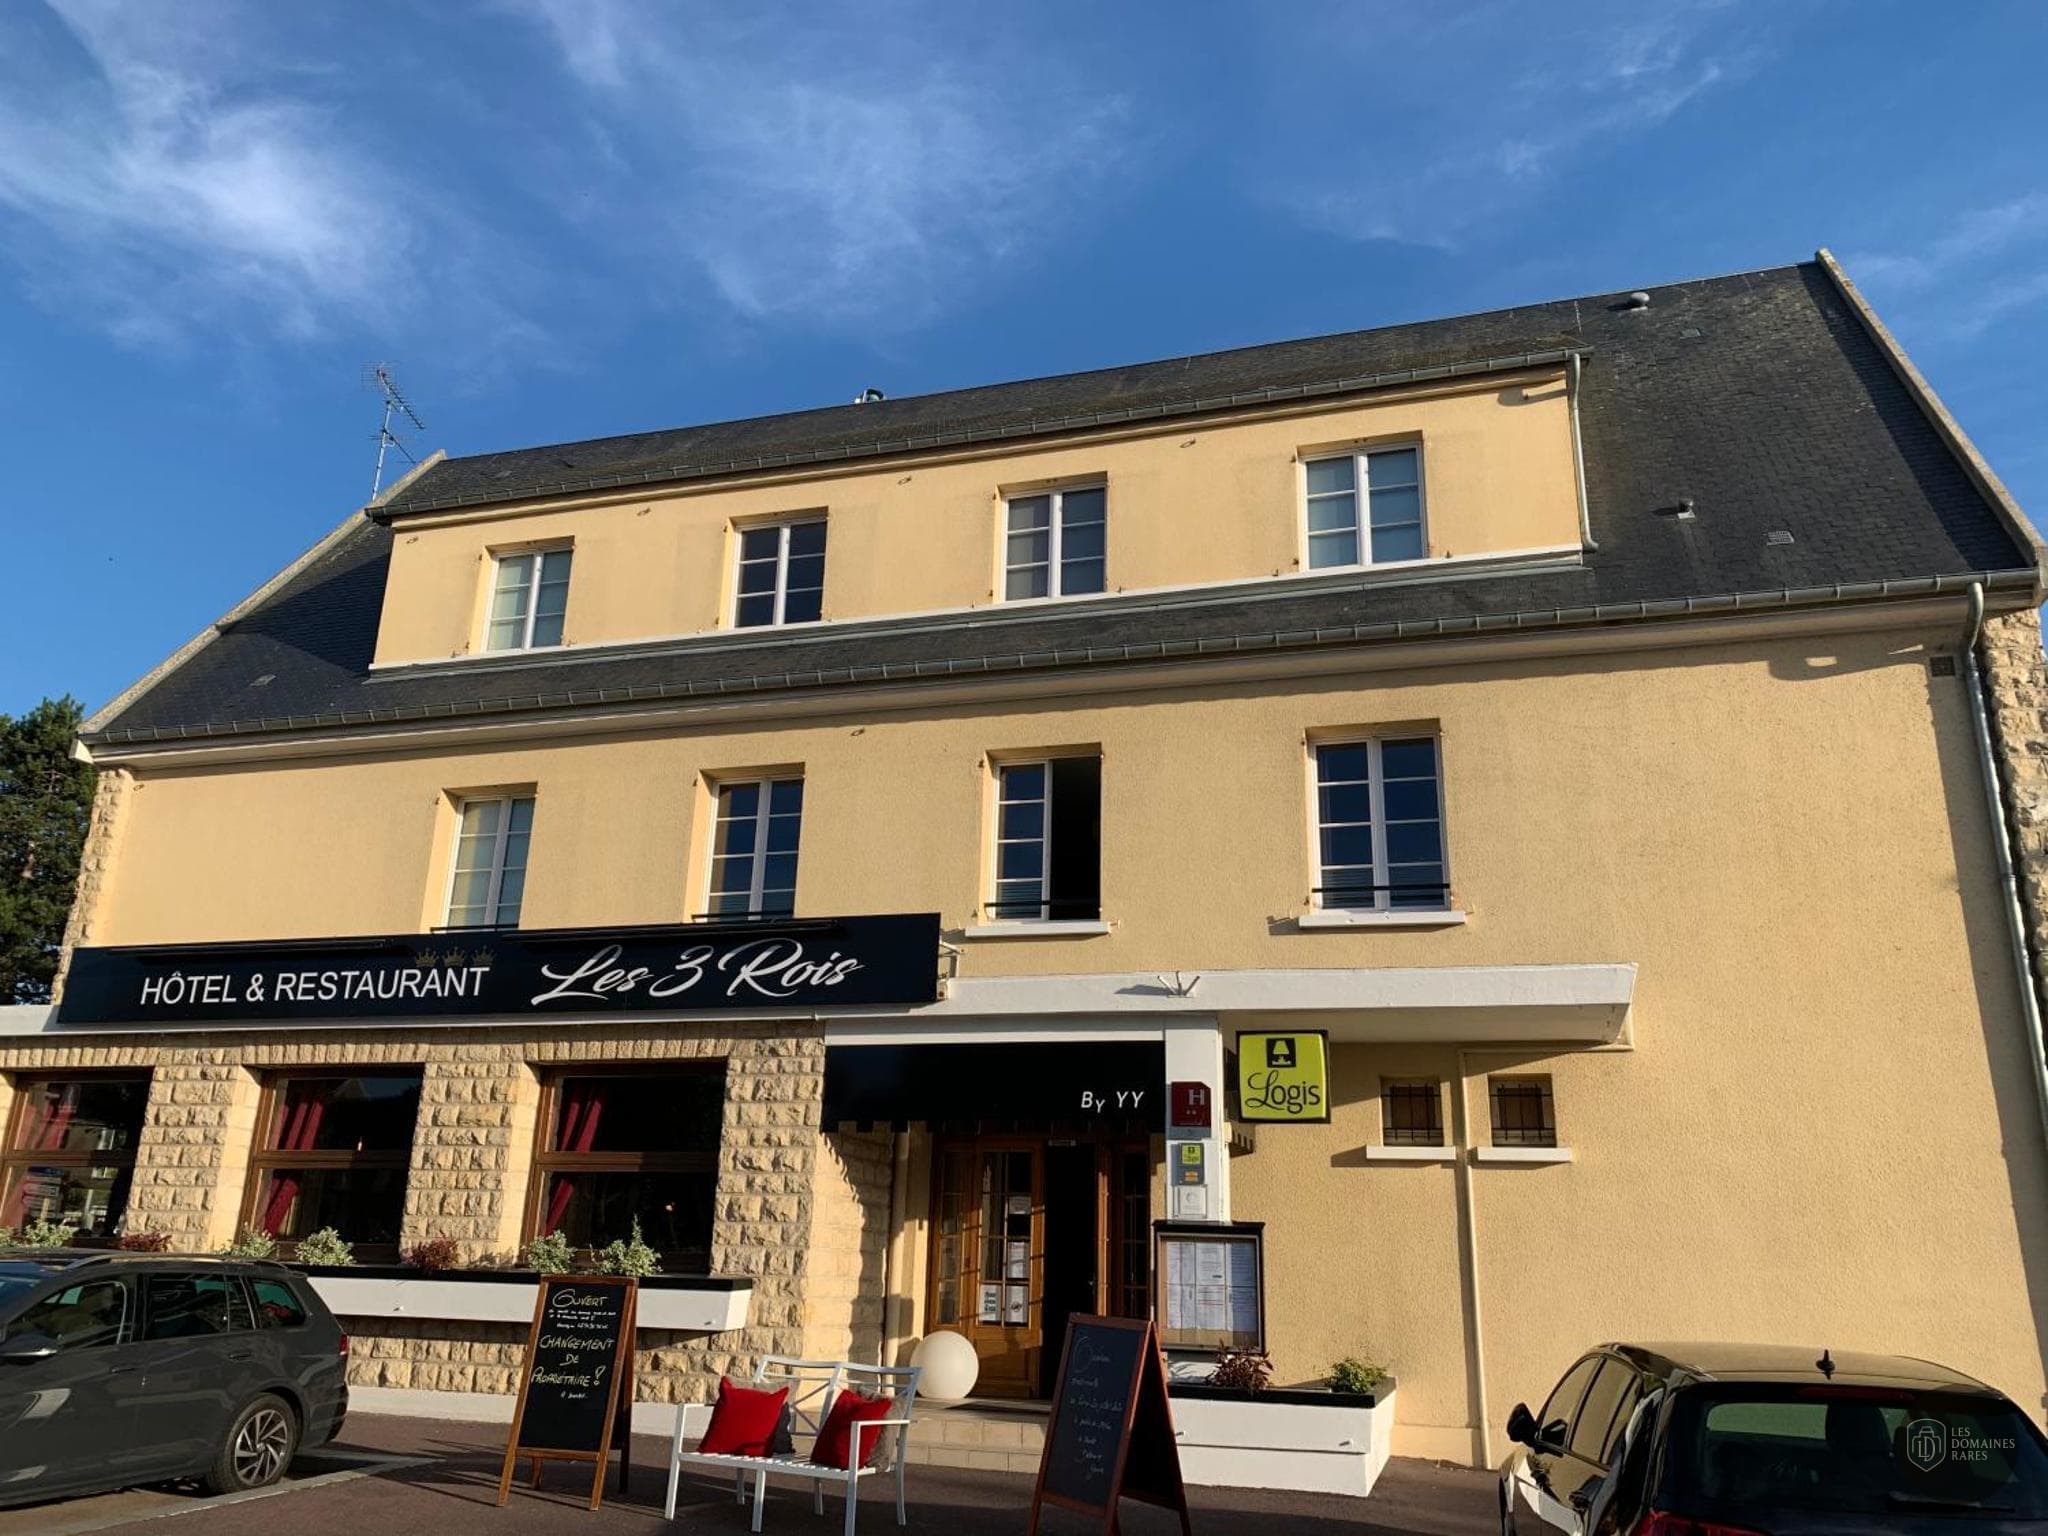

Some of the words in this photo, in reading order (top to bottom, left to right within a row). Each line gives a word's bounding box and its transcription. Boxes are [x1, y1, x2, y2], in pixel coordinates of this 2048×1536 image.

[140, 971, 237, 1005] HÔTEL
[246, 974, 265, 1002] &
[274, 967, 490, 1001] RESTAURANT
[531, 944, 655, 1006] Les
[649, 945, 714, 997] 3
[718, 938, 865, 998] Rois
[1116, 1091, 1144, 1108] YY
[1188, 1089, 1205, 1105] H
[1245, 1069, 1321, 1114] Logis
